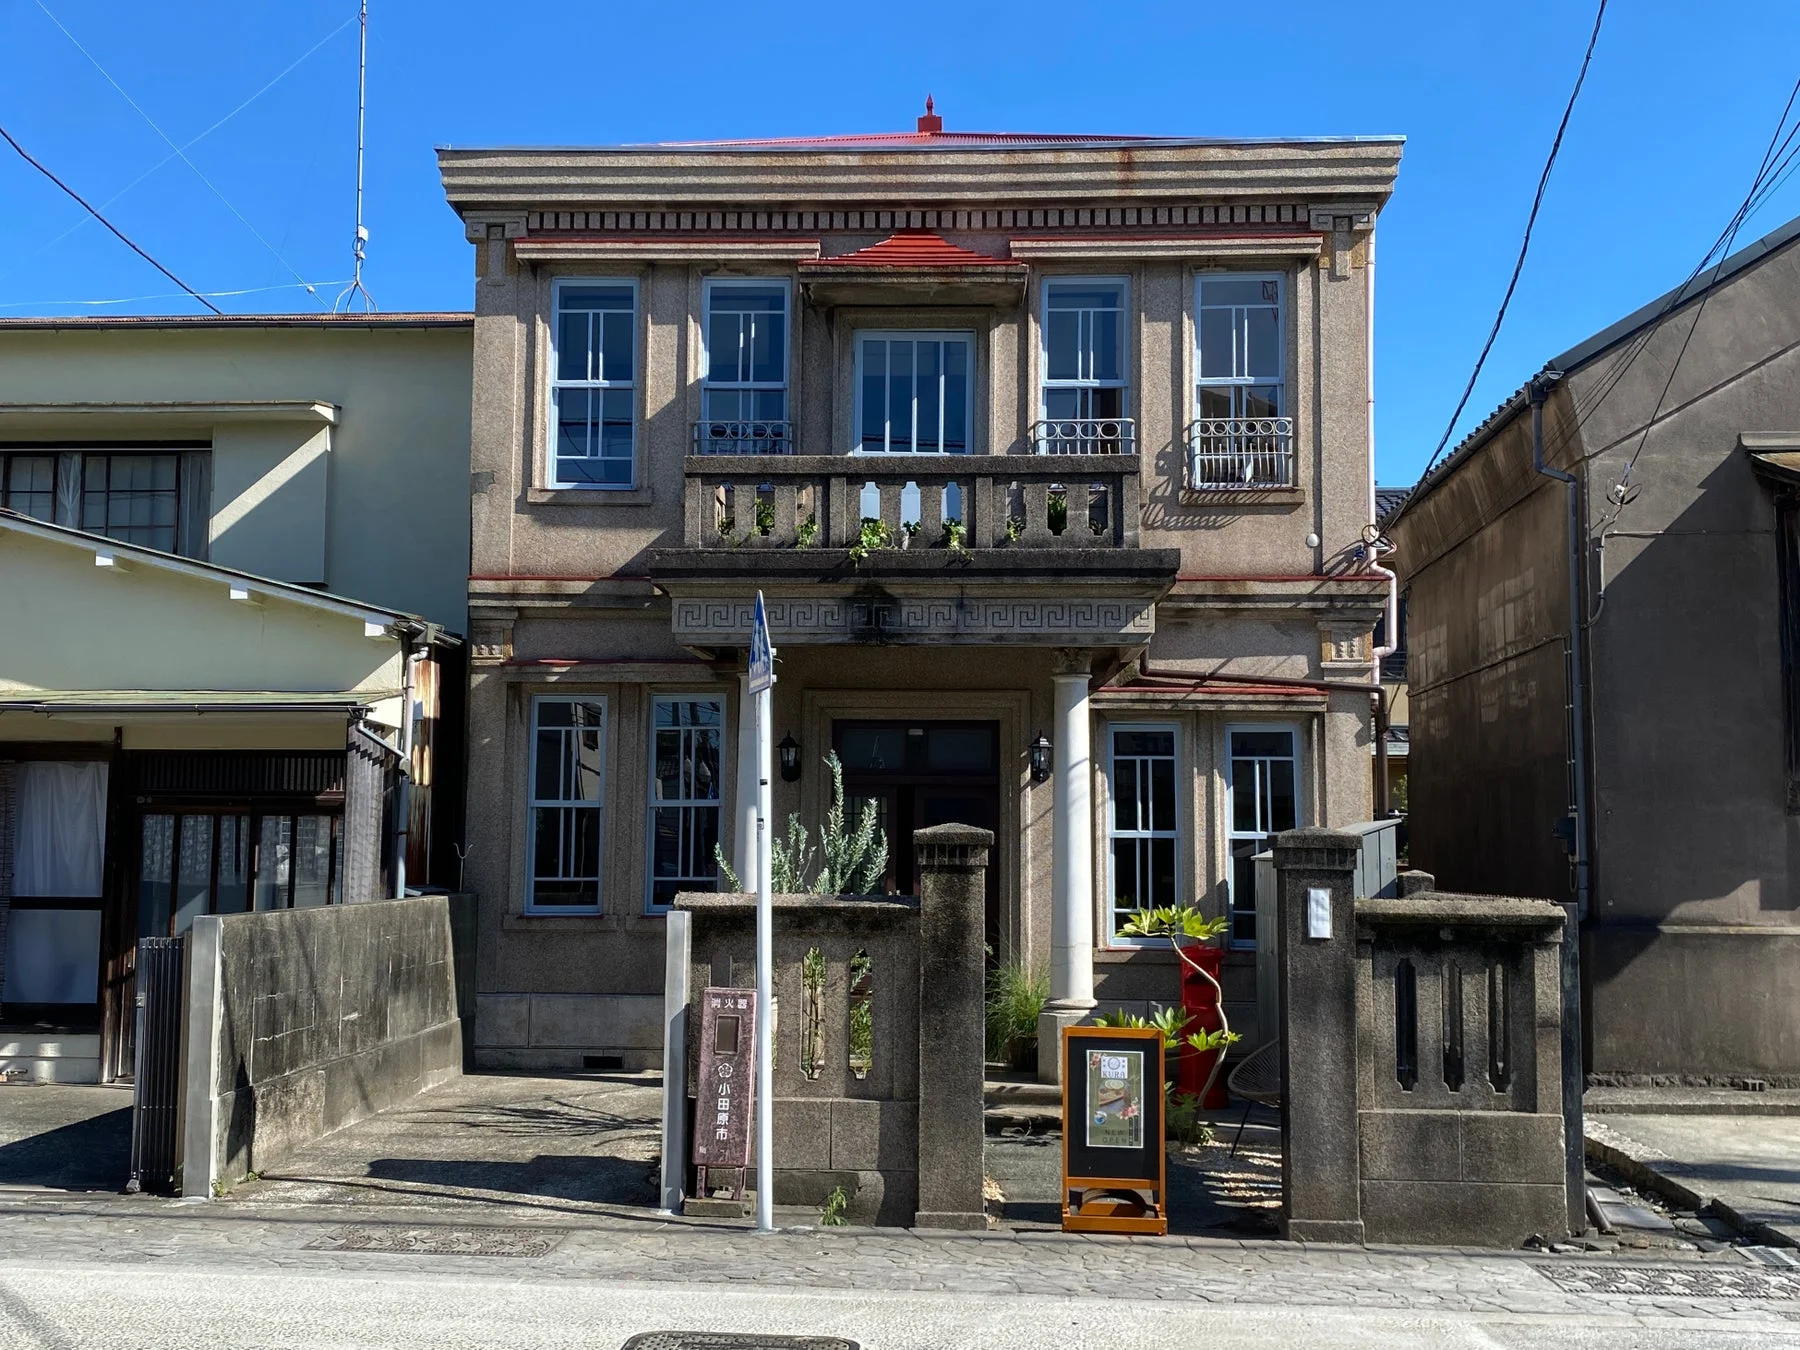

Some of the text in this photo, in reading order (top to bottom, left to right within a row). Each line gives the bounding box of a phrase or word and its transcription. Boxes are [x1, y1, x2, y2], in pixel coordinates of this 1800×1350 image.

[711, 998, 748, 1009] 消火器
[1102, 1071, 1126, 1079] KURA
[716, 1083, 730, 1140] 小田原市
